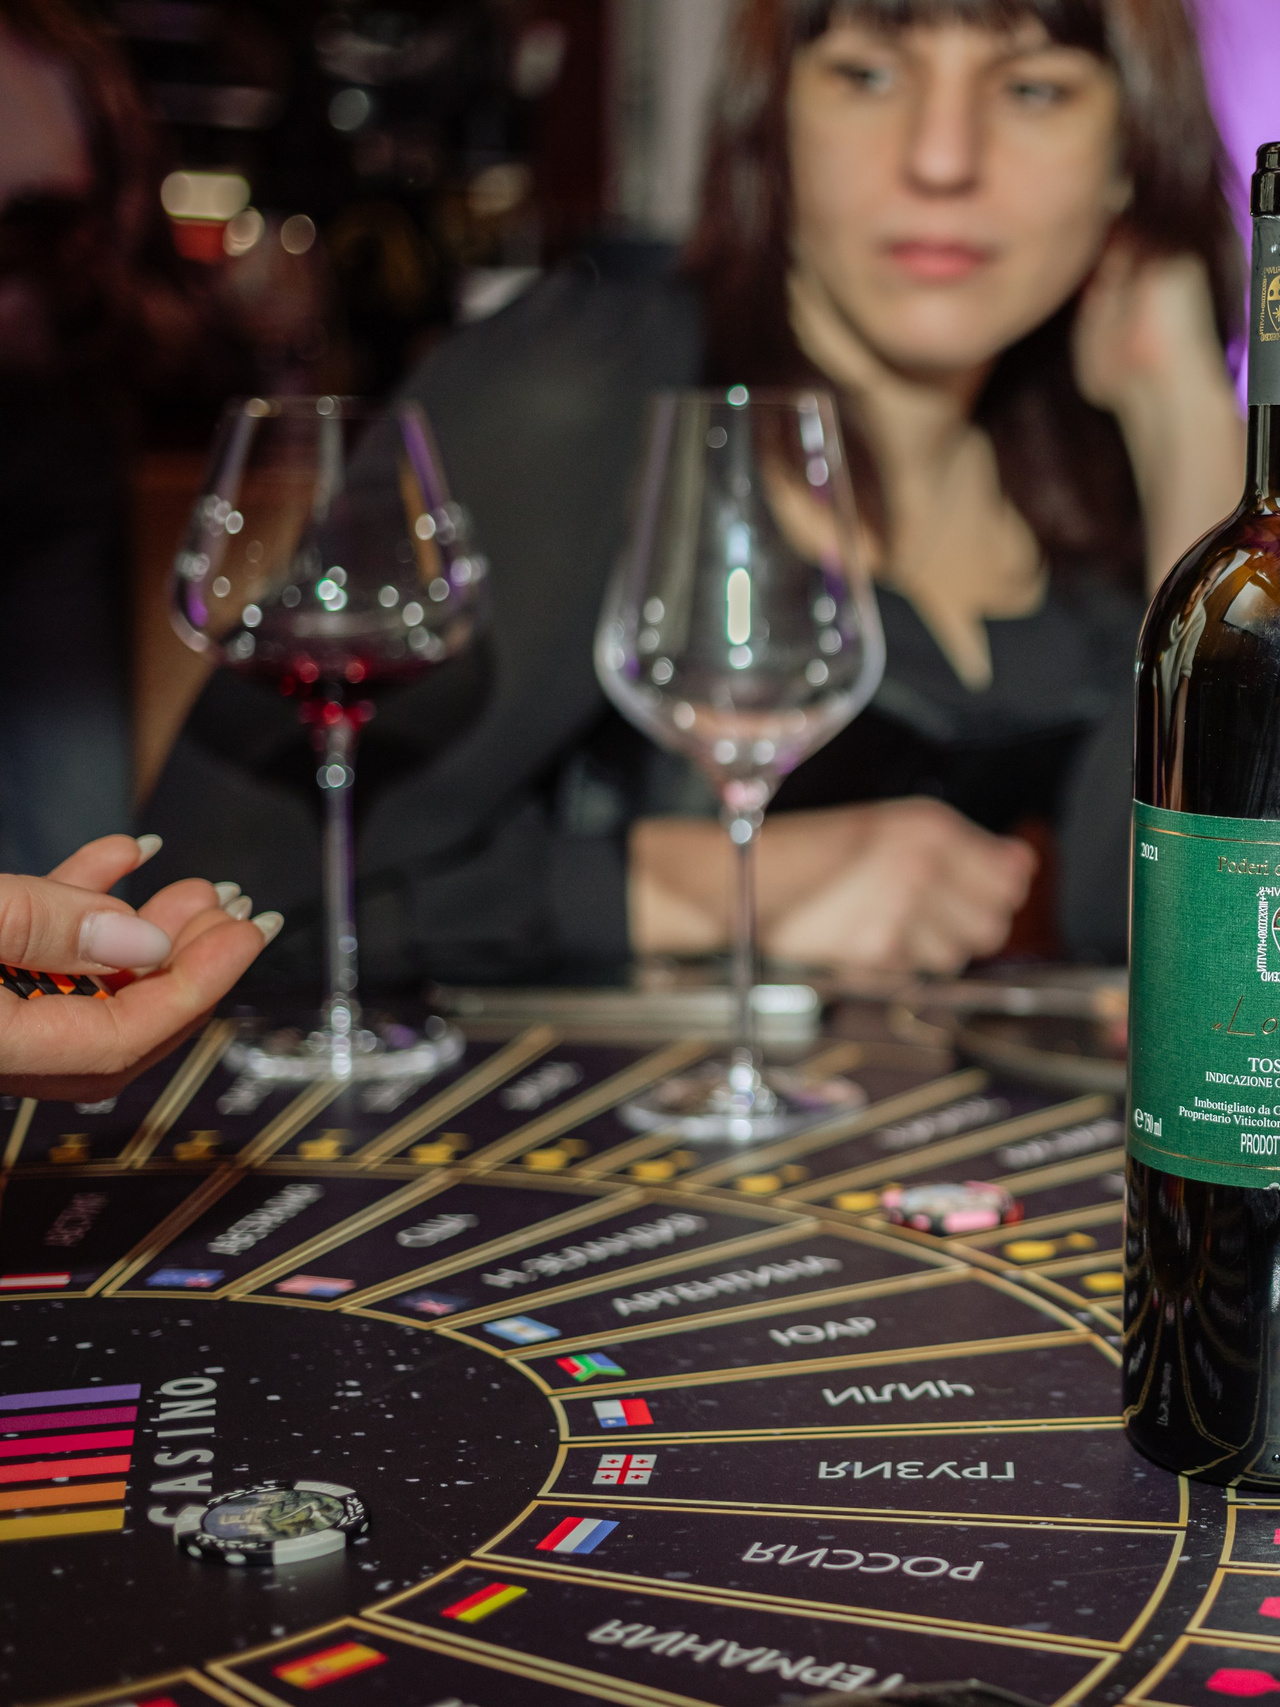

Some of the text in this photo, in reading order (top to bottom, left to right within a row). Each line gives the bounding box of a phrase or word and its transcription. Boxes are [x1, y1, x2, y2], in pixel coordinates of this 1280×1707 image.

[1140, 843, 1159, 861] 2021
[1217, 856, 1269, 876] Poderi
[1205, 1071, 1273, 1088] INDICAZIONE
[1179, 1105, 1231, 1126] Proprietario
[1194, 1097, 1256, 1117] Imbottigliato
[1258, 1103, 1271, 1115] da
[769, 1316, 877, 1347] ЮАР
[821, 1379, 974, 1406] ЧИЛИ
[818, 1461, 1015, 1480] ГРУЗИЯ
[742, 1540, 984, 1582] РОССИЯ
